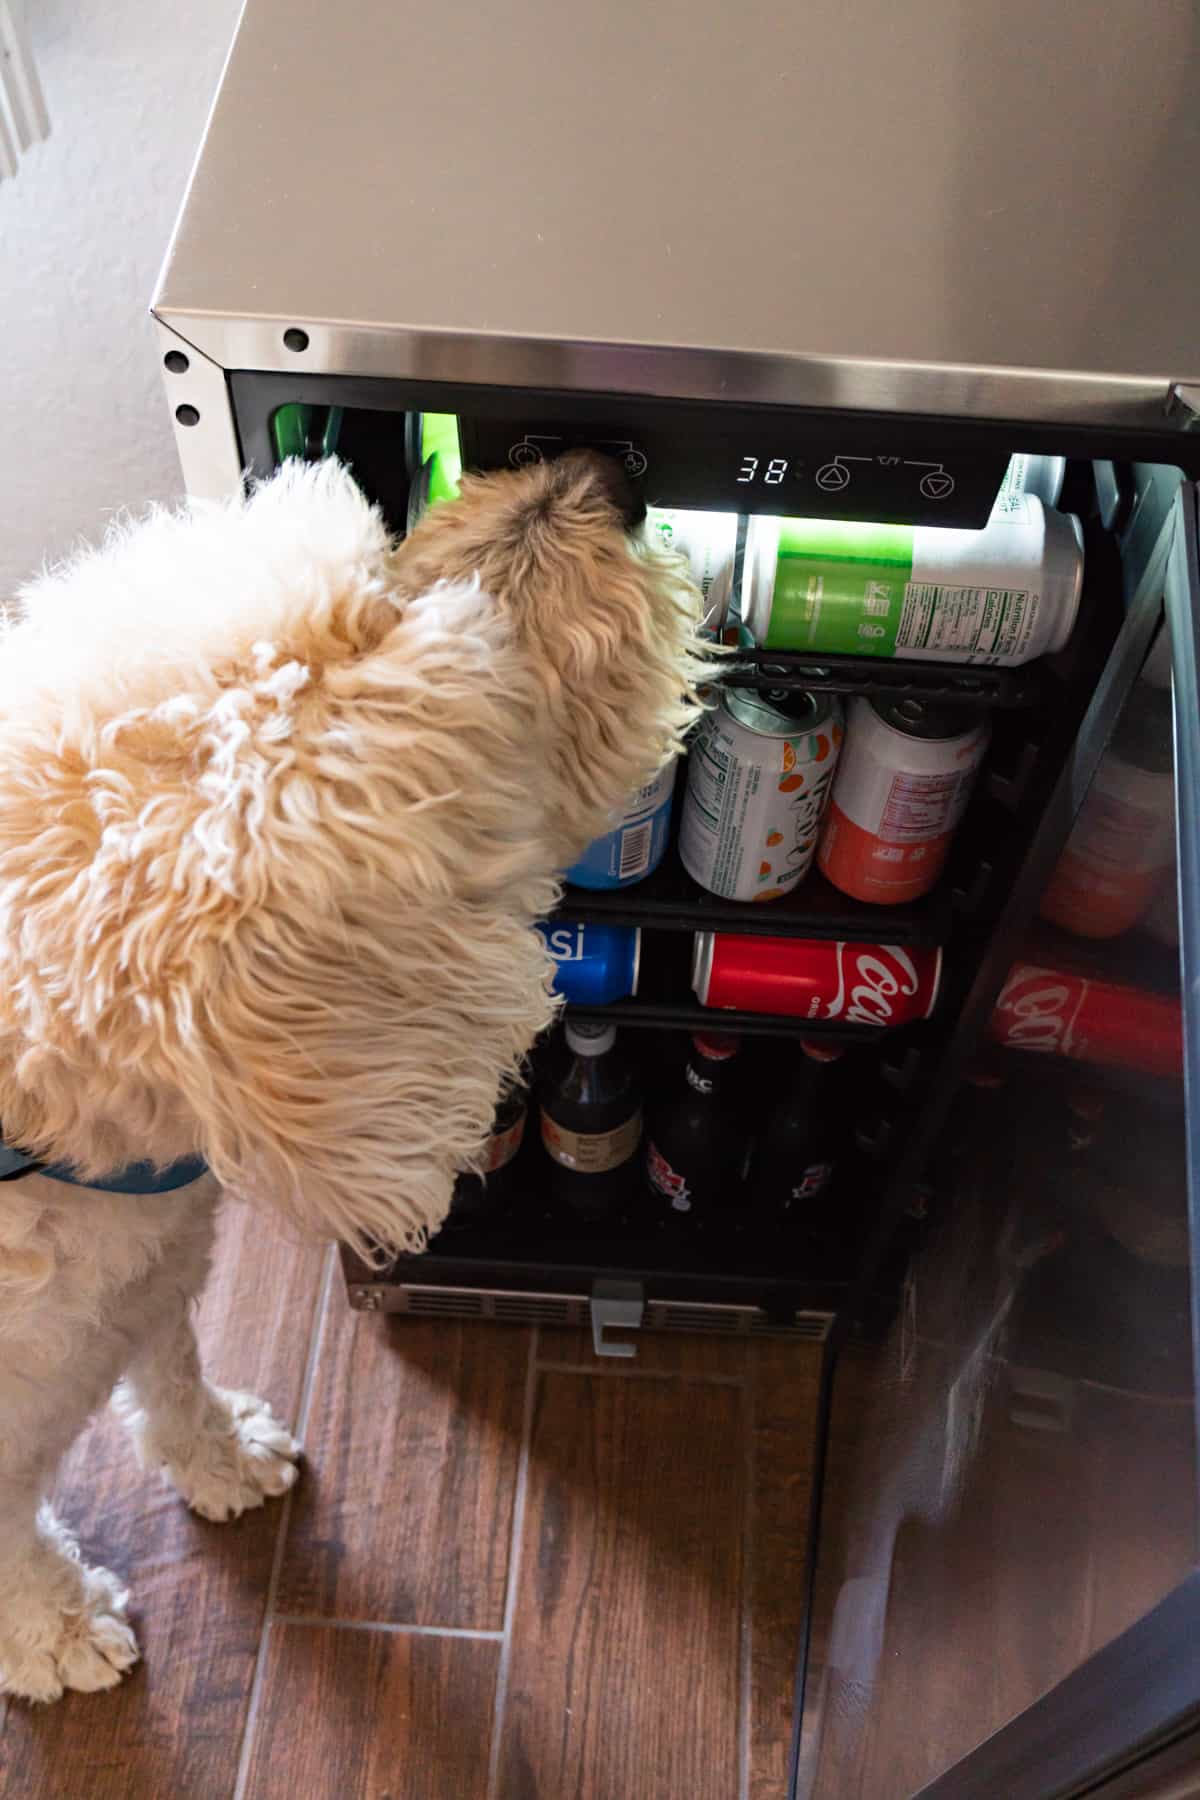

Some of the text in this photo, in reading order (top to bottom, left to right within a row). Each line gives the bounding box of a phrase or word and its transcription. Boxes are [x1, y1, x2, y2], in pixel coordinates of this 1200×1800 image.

[736, 456, 788, 485] 38
[984, 592, 998, 629] Calories
[1009, 592, 1026, 634] Nutrition
